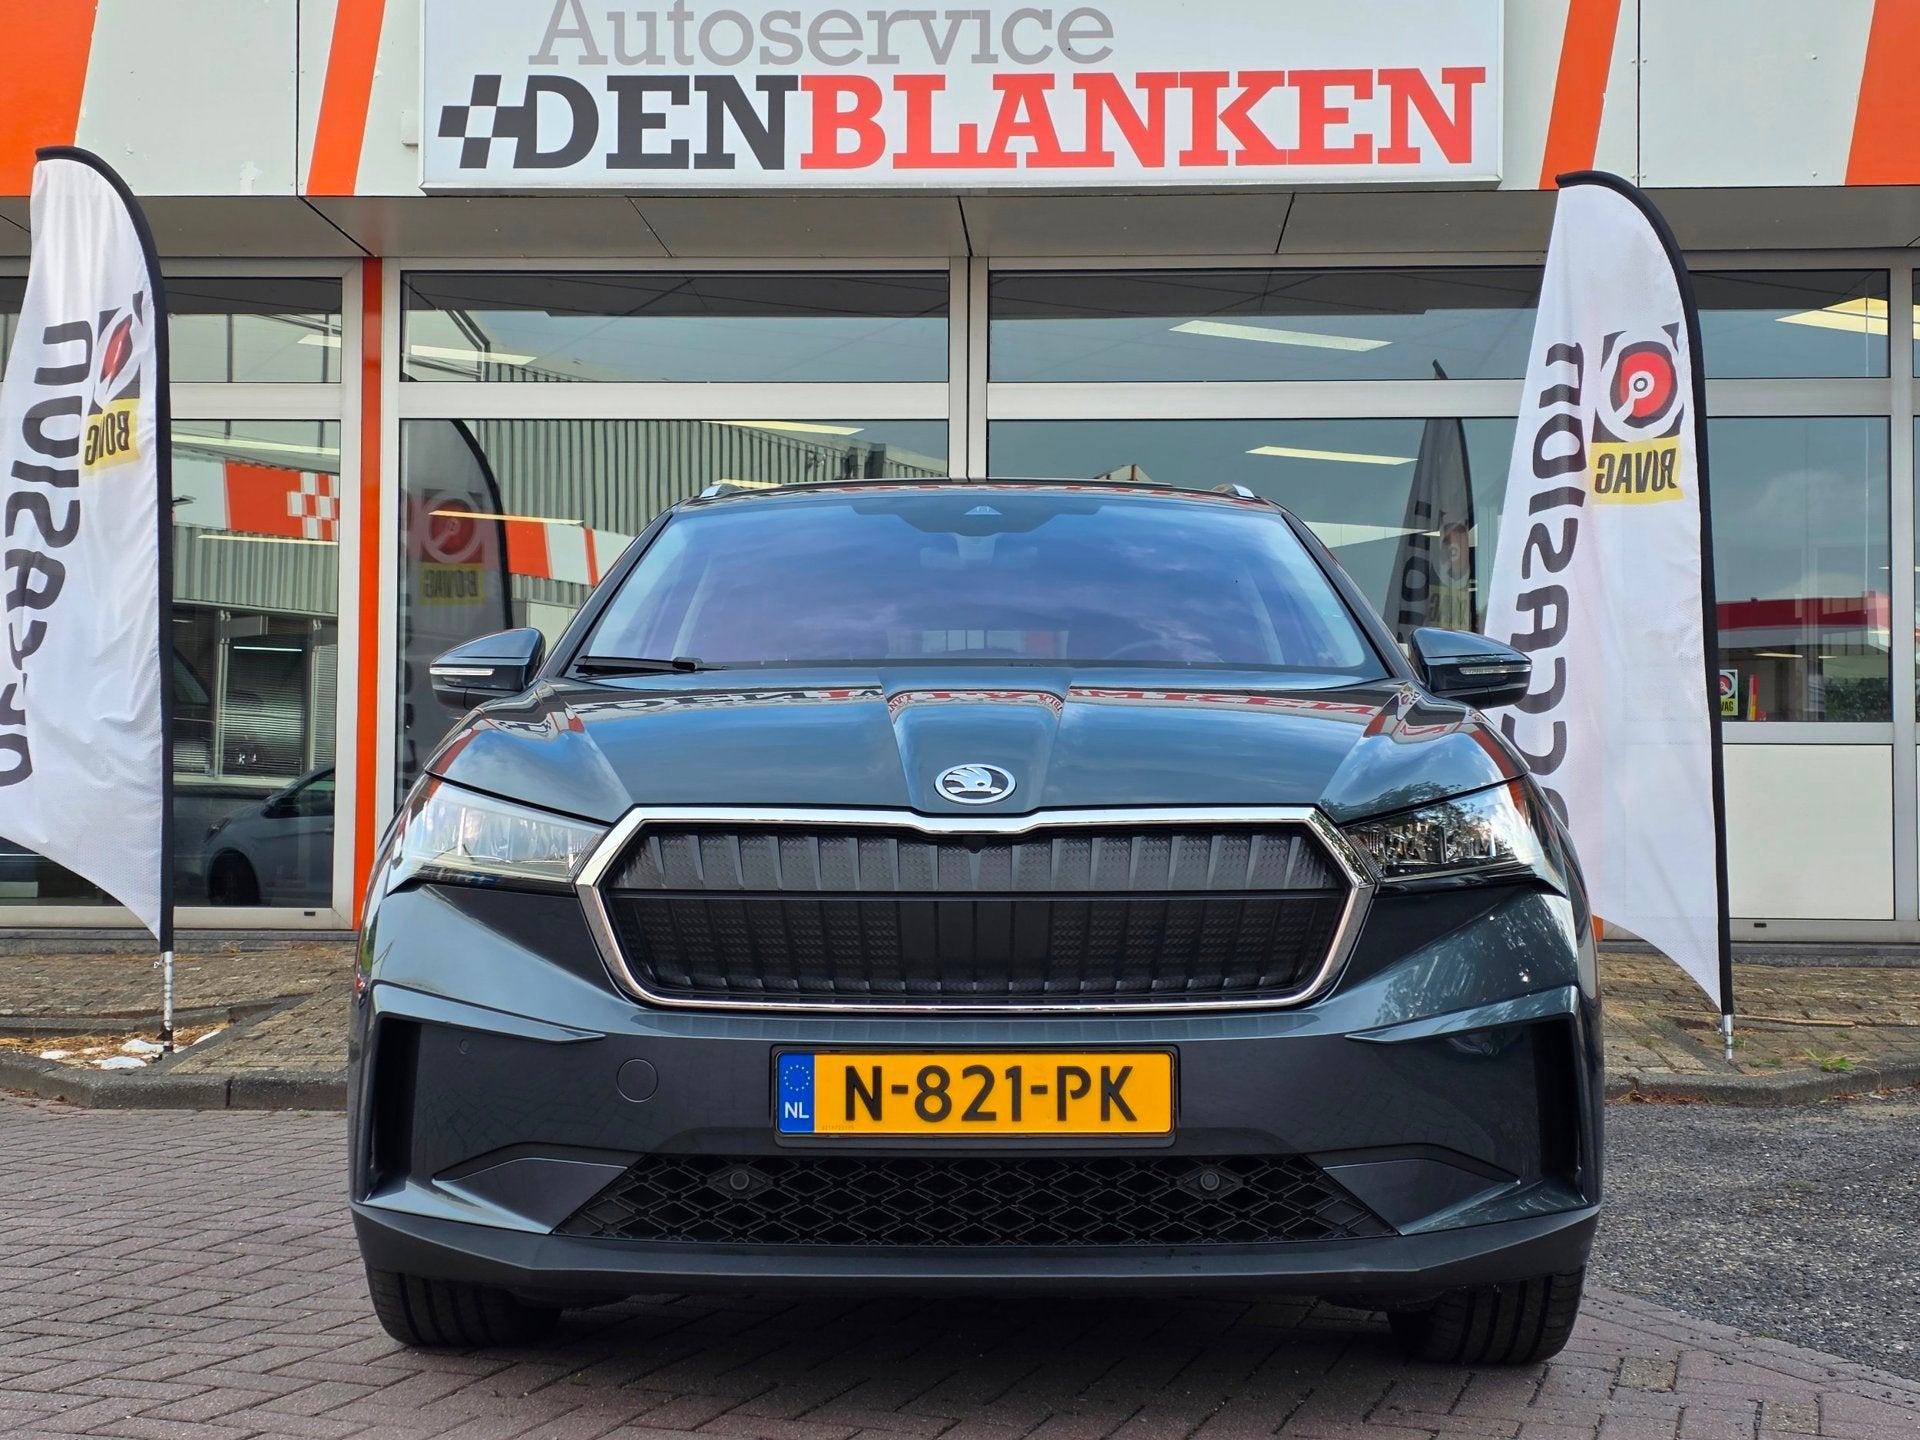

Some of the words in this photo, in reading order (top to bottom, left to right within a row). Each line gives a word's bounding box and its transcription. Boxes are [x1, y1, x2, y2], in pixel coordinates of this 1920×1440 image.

[528, 0, 1114, 66] Autoservice
[784, 1101, 810, 1119] NL
[845, 1064, 1138, 1123] N-821-PK
